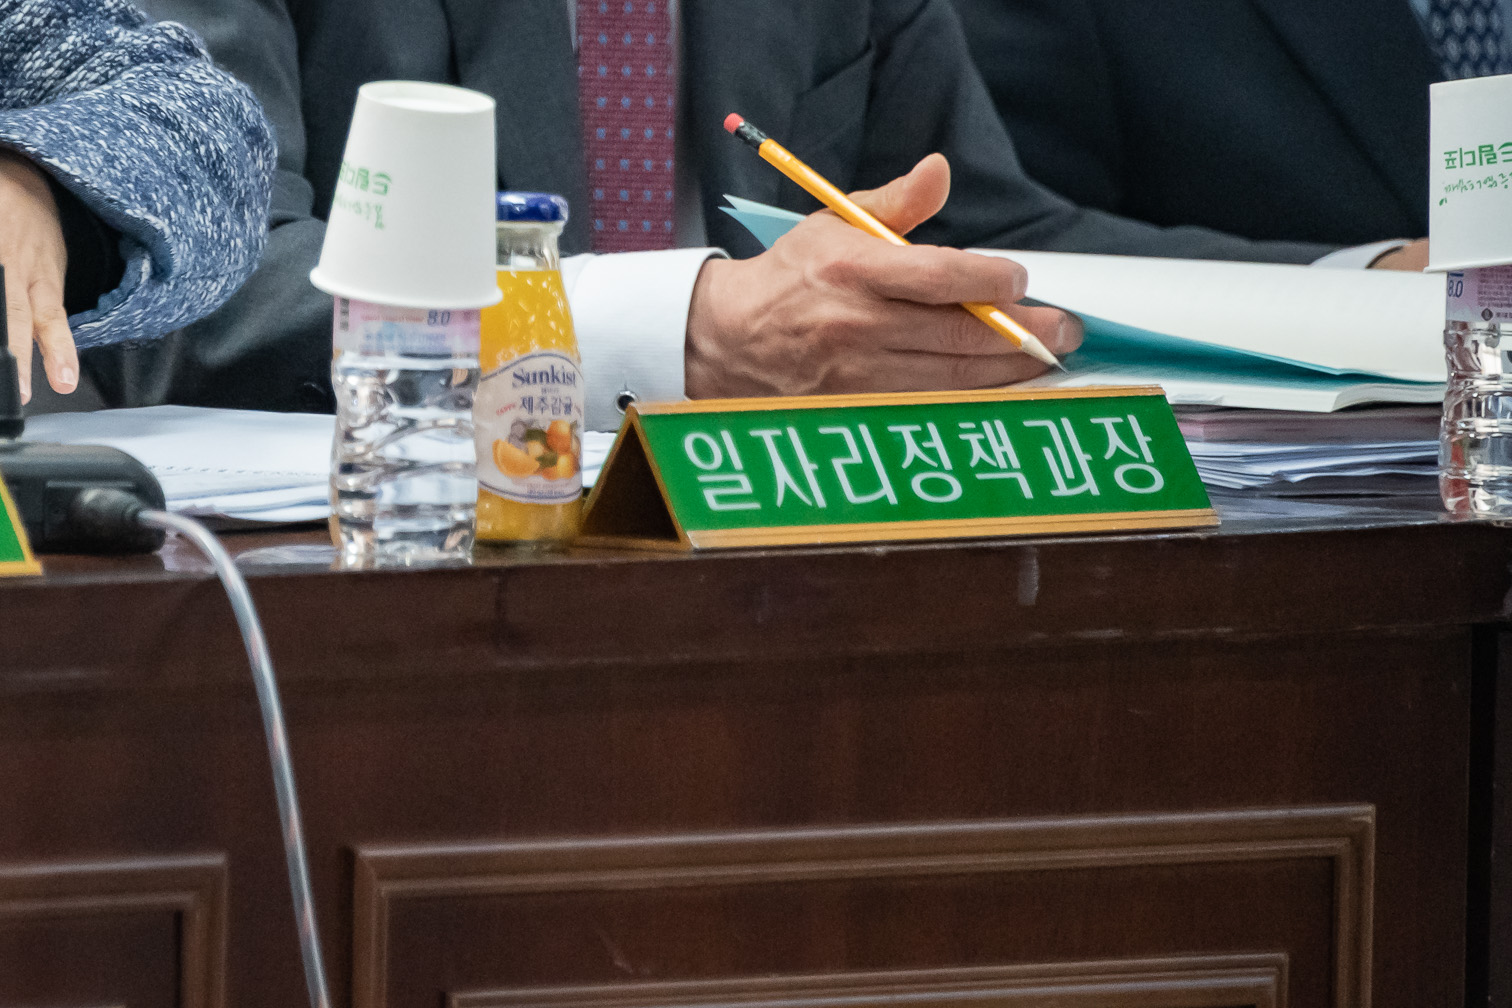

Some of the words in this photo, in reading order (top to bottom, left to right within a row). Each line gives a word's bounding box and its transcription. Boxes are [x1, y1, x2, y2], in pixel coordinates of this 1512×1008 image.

[512, 365, 576, 388] Sunkist
[519, 396, 573, 416] 제주감귤
[683, 412, 1165, 513] 일자리정책과장
